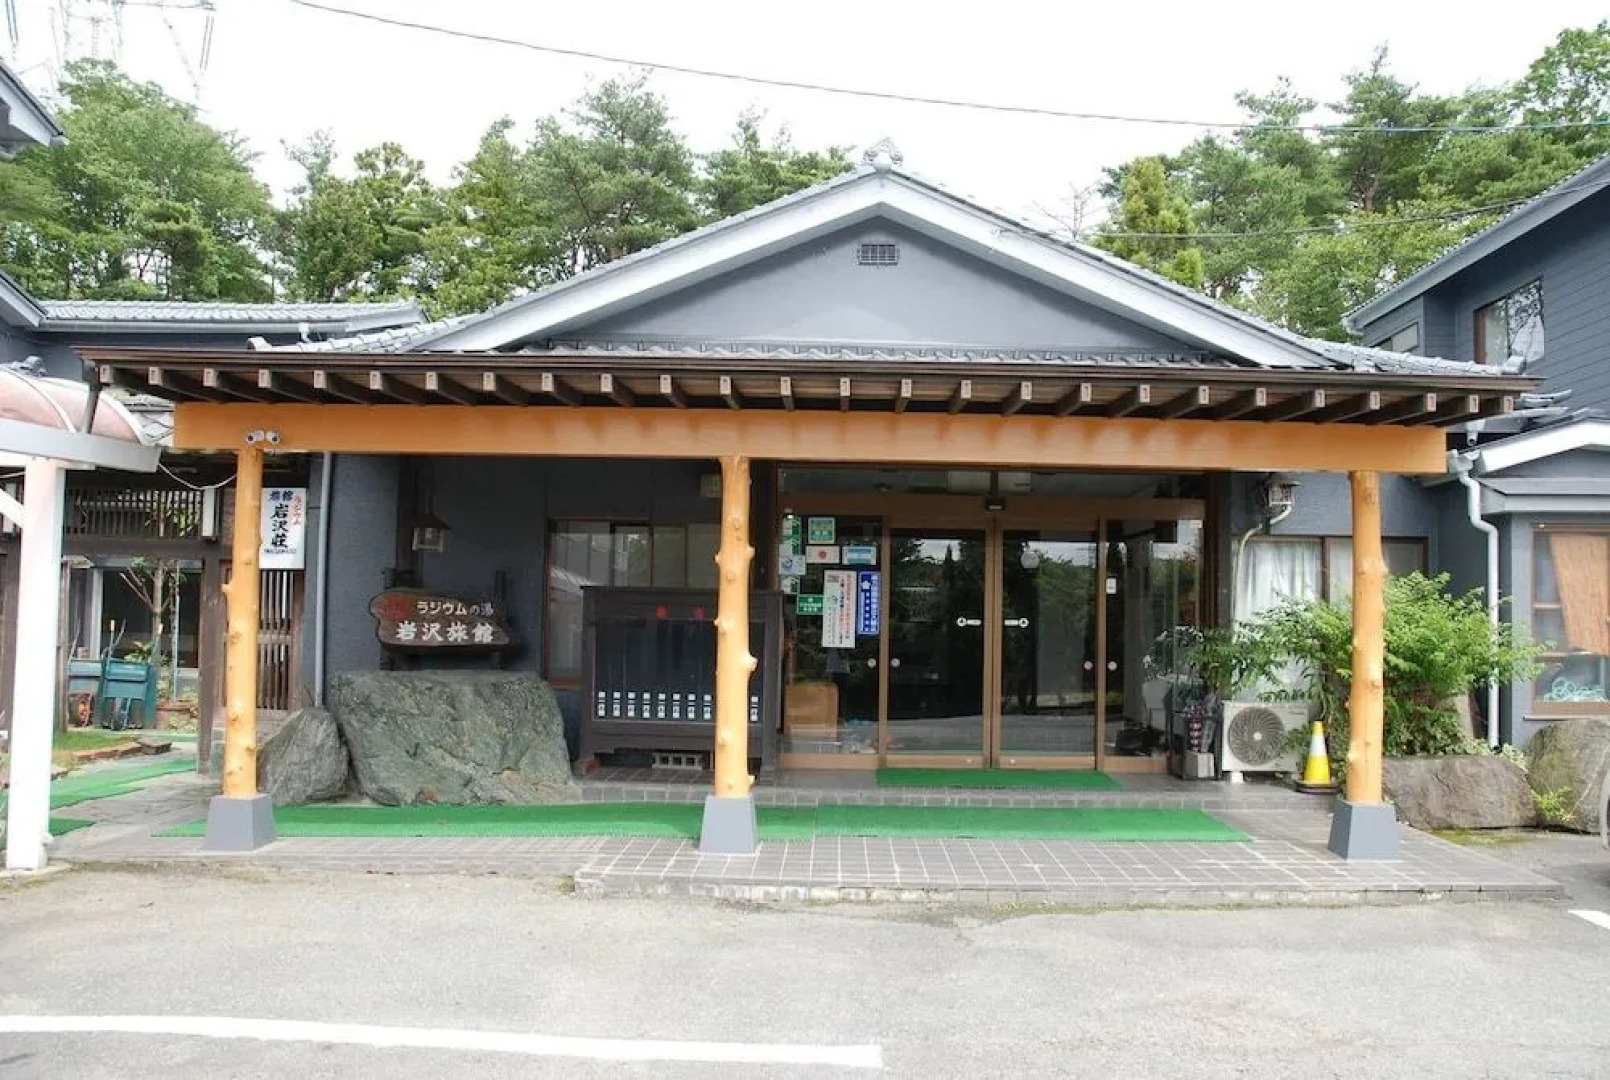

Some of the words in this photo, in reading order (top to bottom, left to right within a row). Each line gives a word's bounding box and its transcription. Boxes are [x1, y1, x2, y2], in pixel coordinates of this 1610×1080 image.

[416, 601, 494, 617] ラジウムの湯
[396, 620, 494, 643] 岩沢旅館
